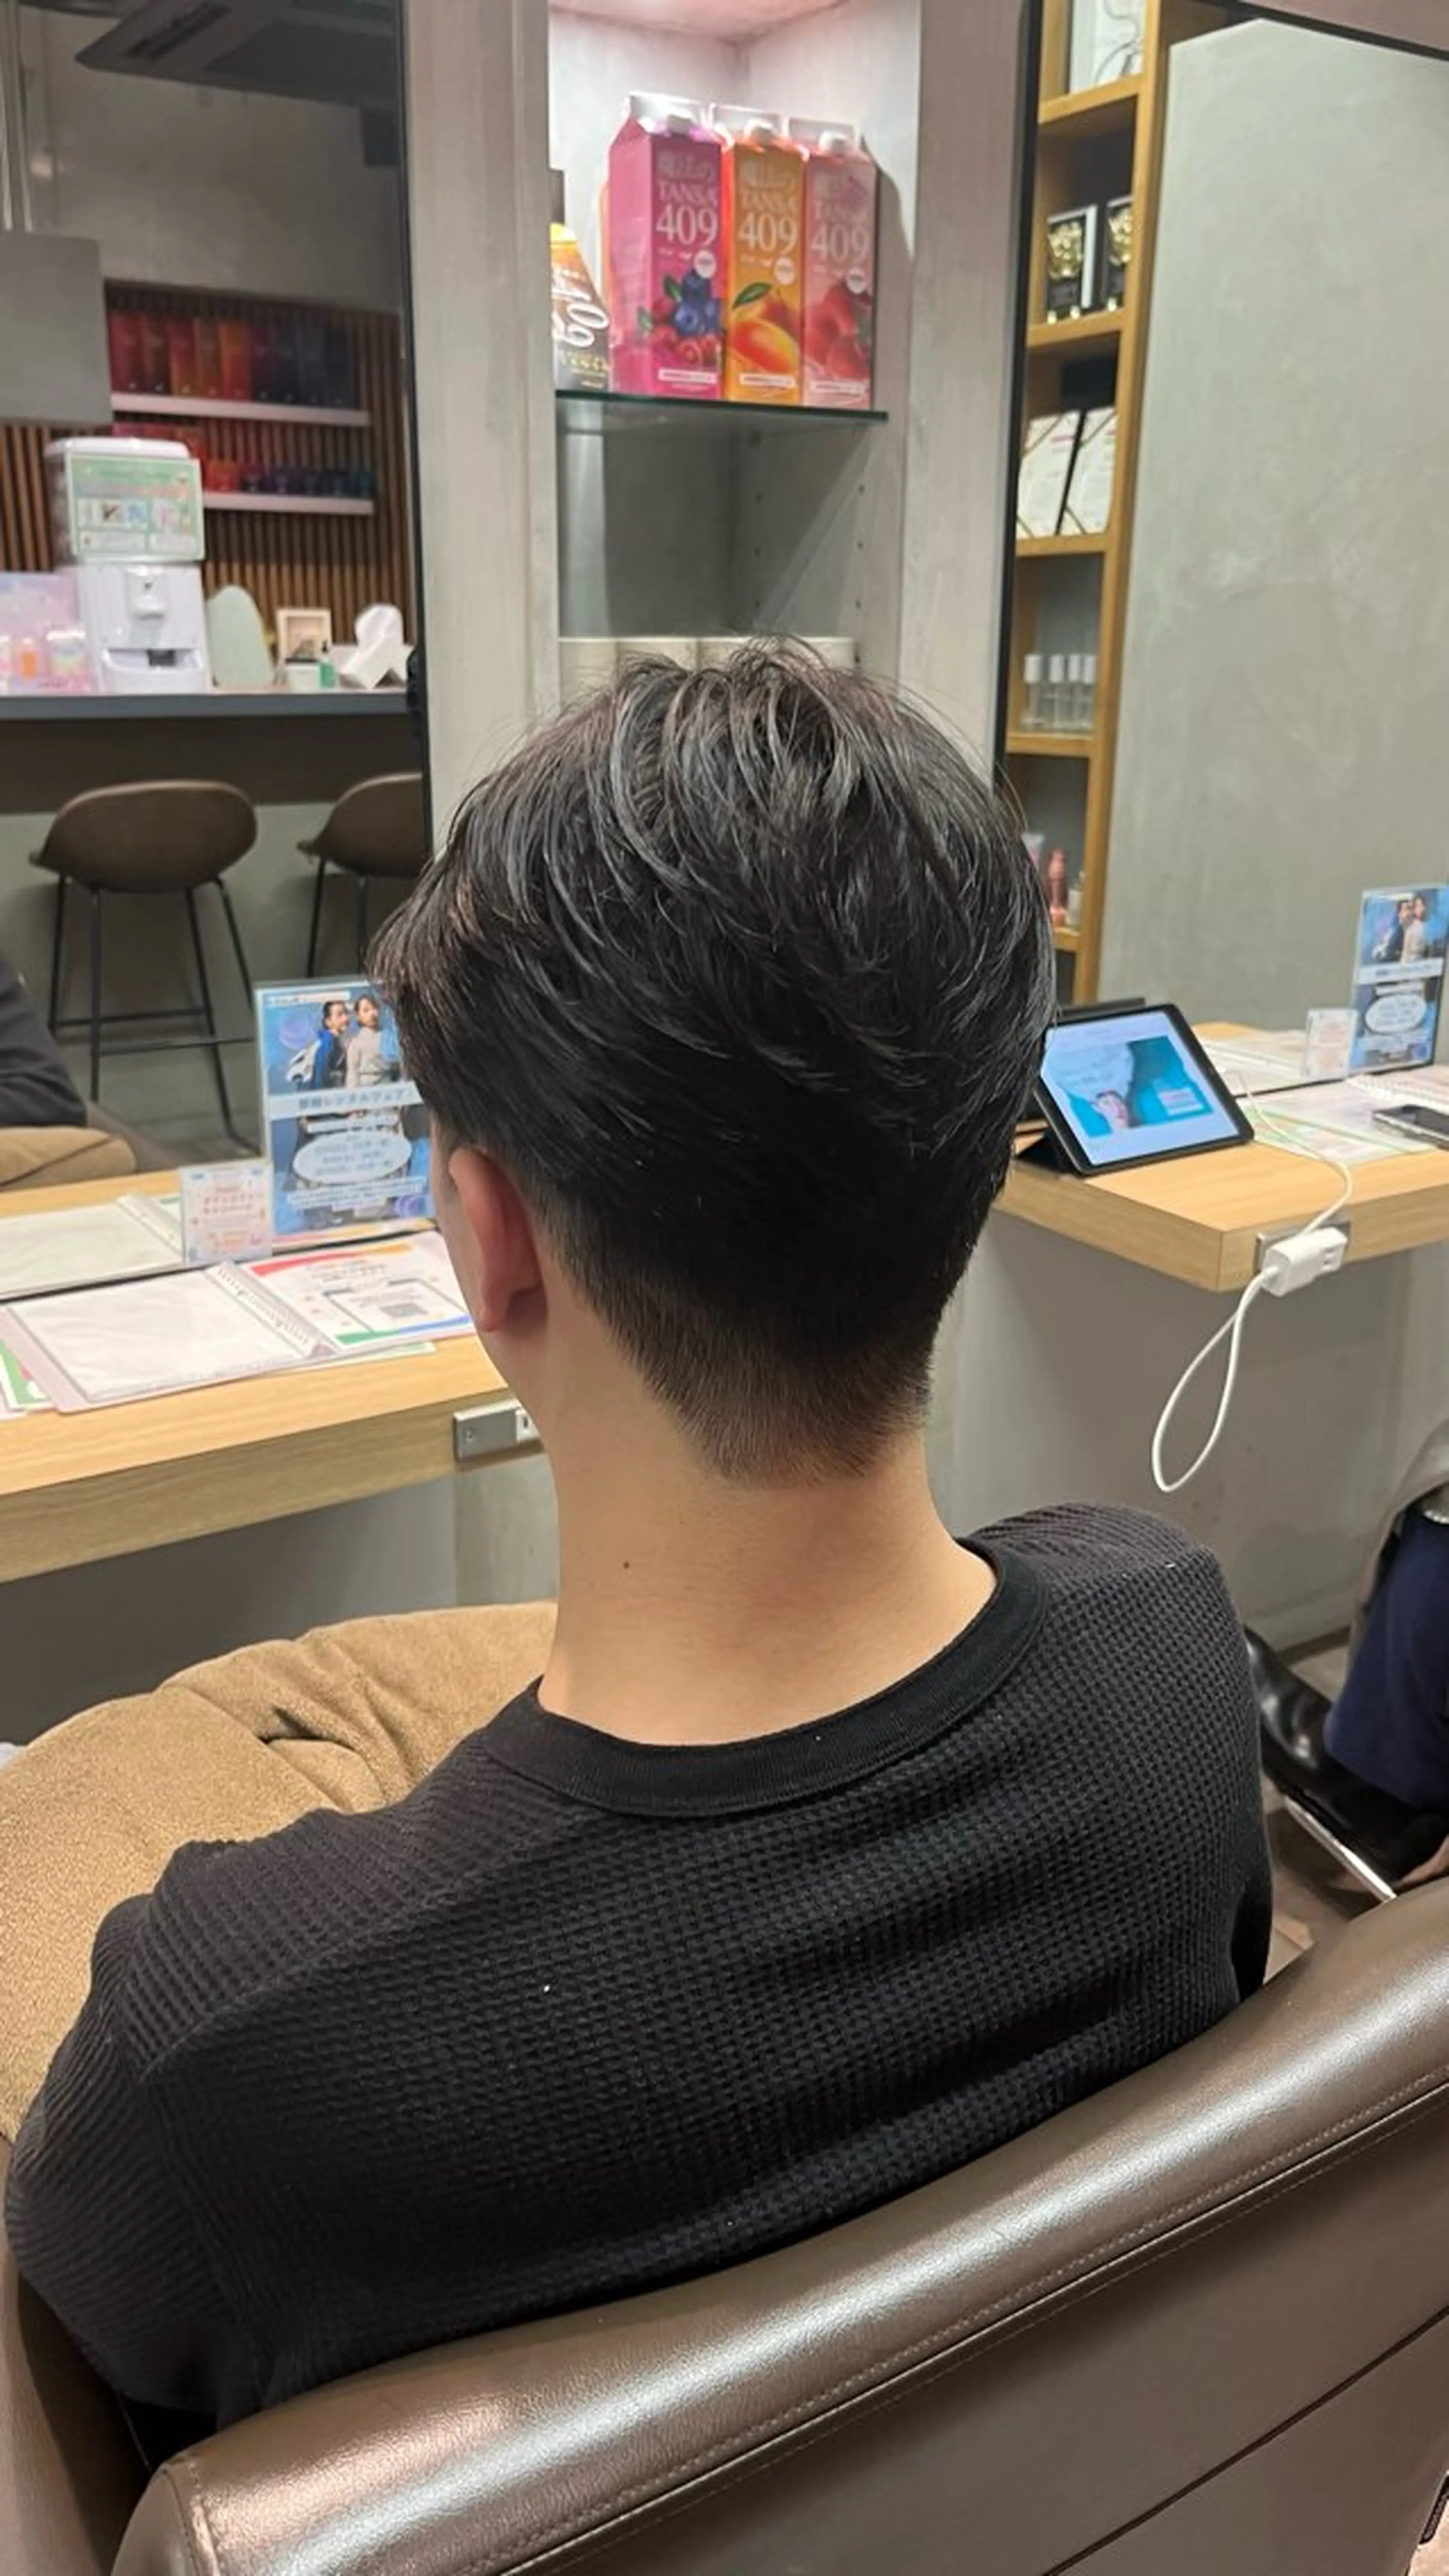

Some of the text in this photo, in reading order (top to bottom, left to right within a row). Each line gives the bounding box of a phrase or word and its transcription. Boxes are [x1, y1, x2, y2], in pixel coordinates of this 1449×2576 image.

[655, 203, 718, 246] 409
[738, 213, 797, 255] 409
[811, 223, 869, 263] 409
